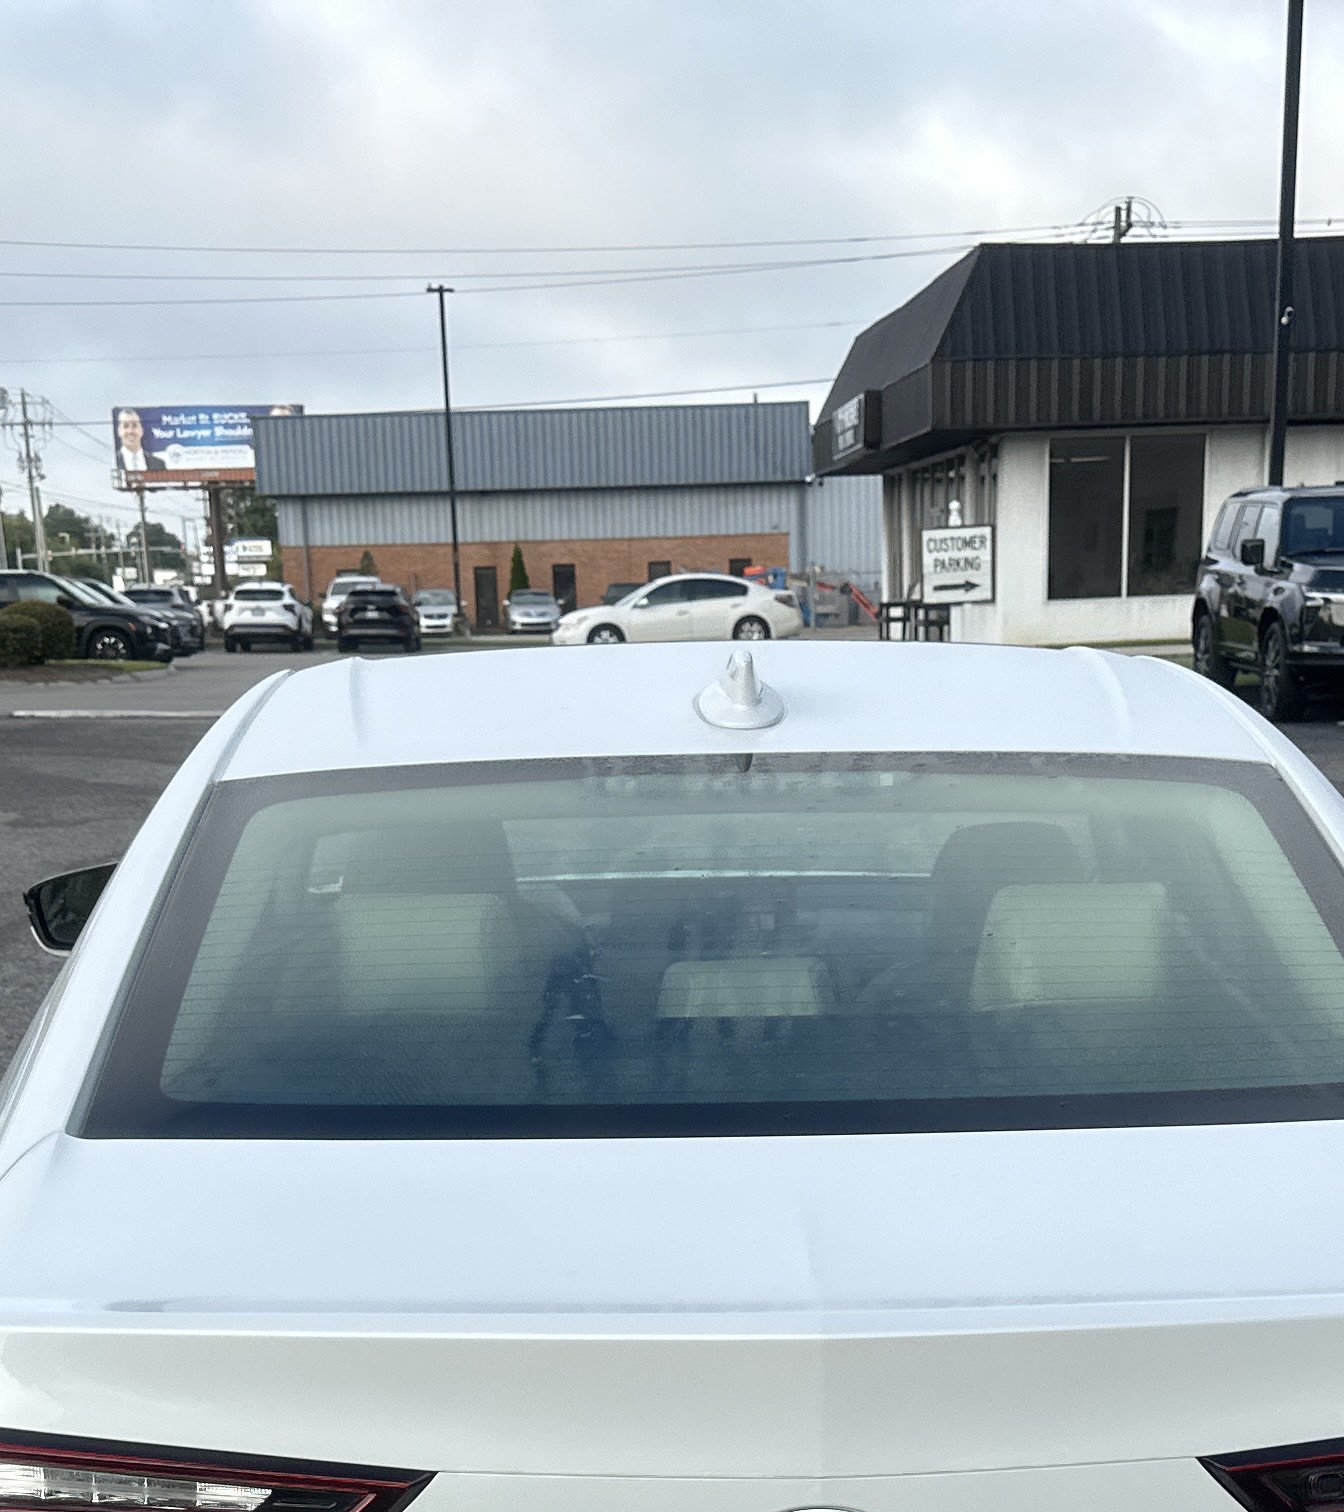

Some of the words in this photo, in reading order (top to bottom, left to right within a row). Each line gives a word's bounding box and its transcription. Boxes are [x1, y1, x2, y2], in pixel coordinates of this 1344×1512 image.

[151, 427, 175, 439] Your
[175, 427, 212, 440] Lawyer
[926, 535, 987, 553] CUSTOMER
[933, 556, 981, 574] PARKING
